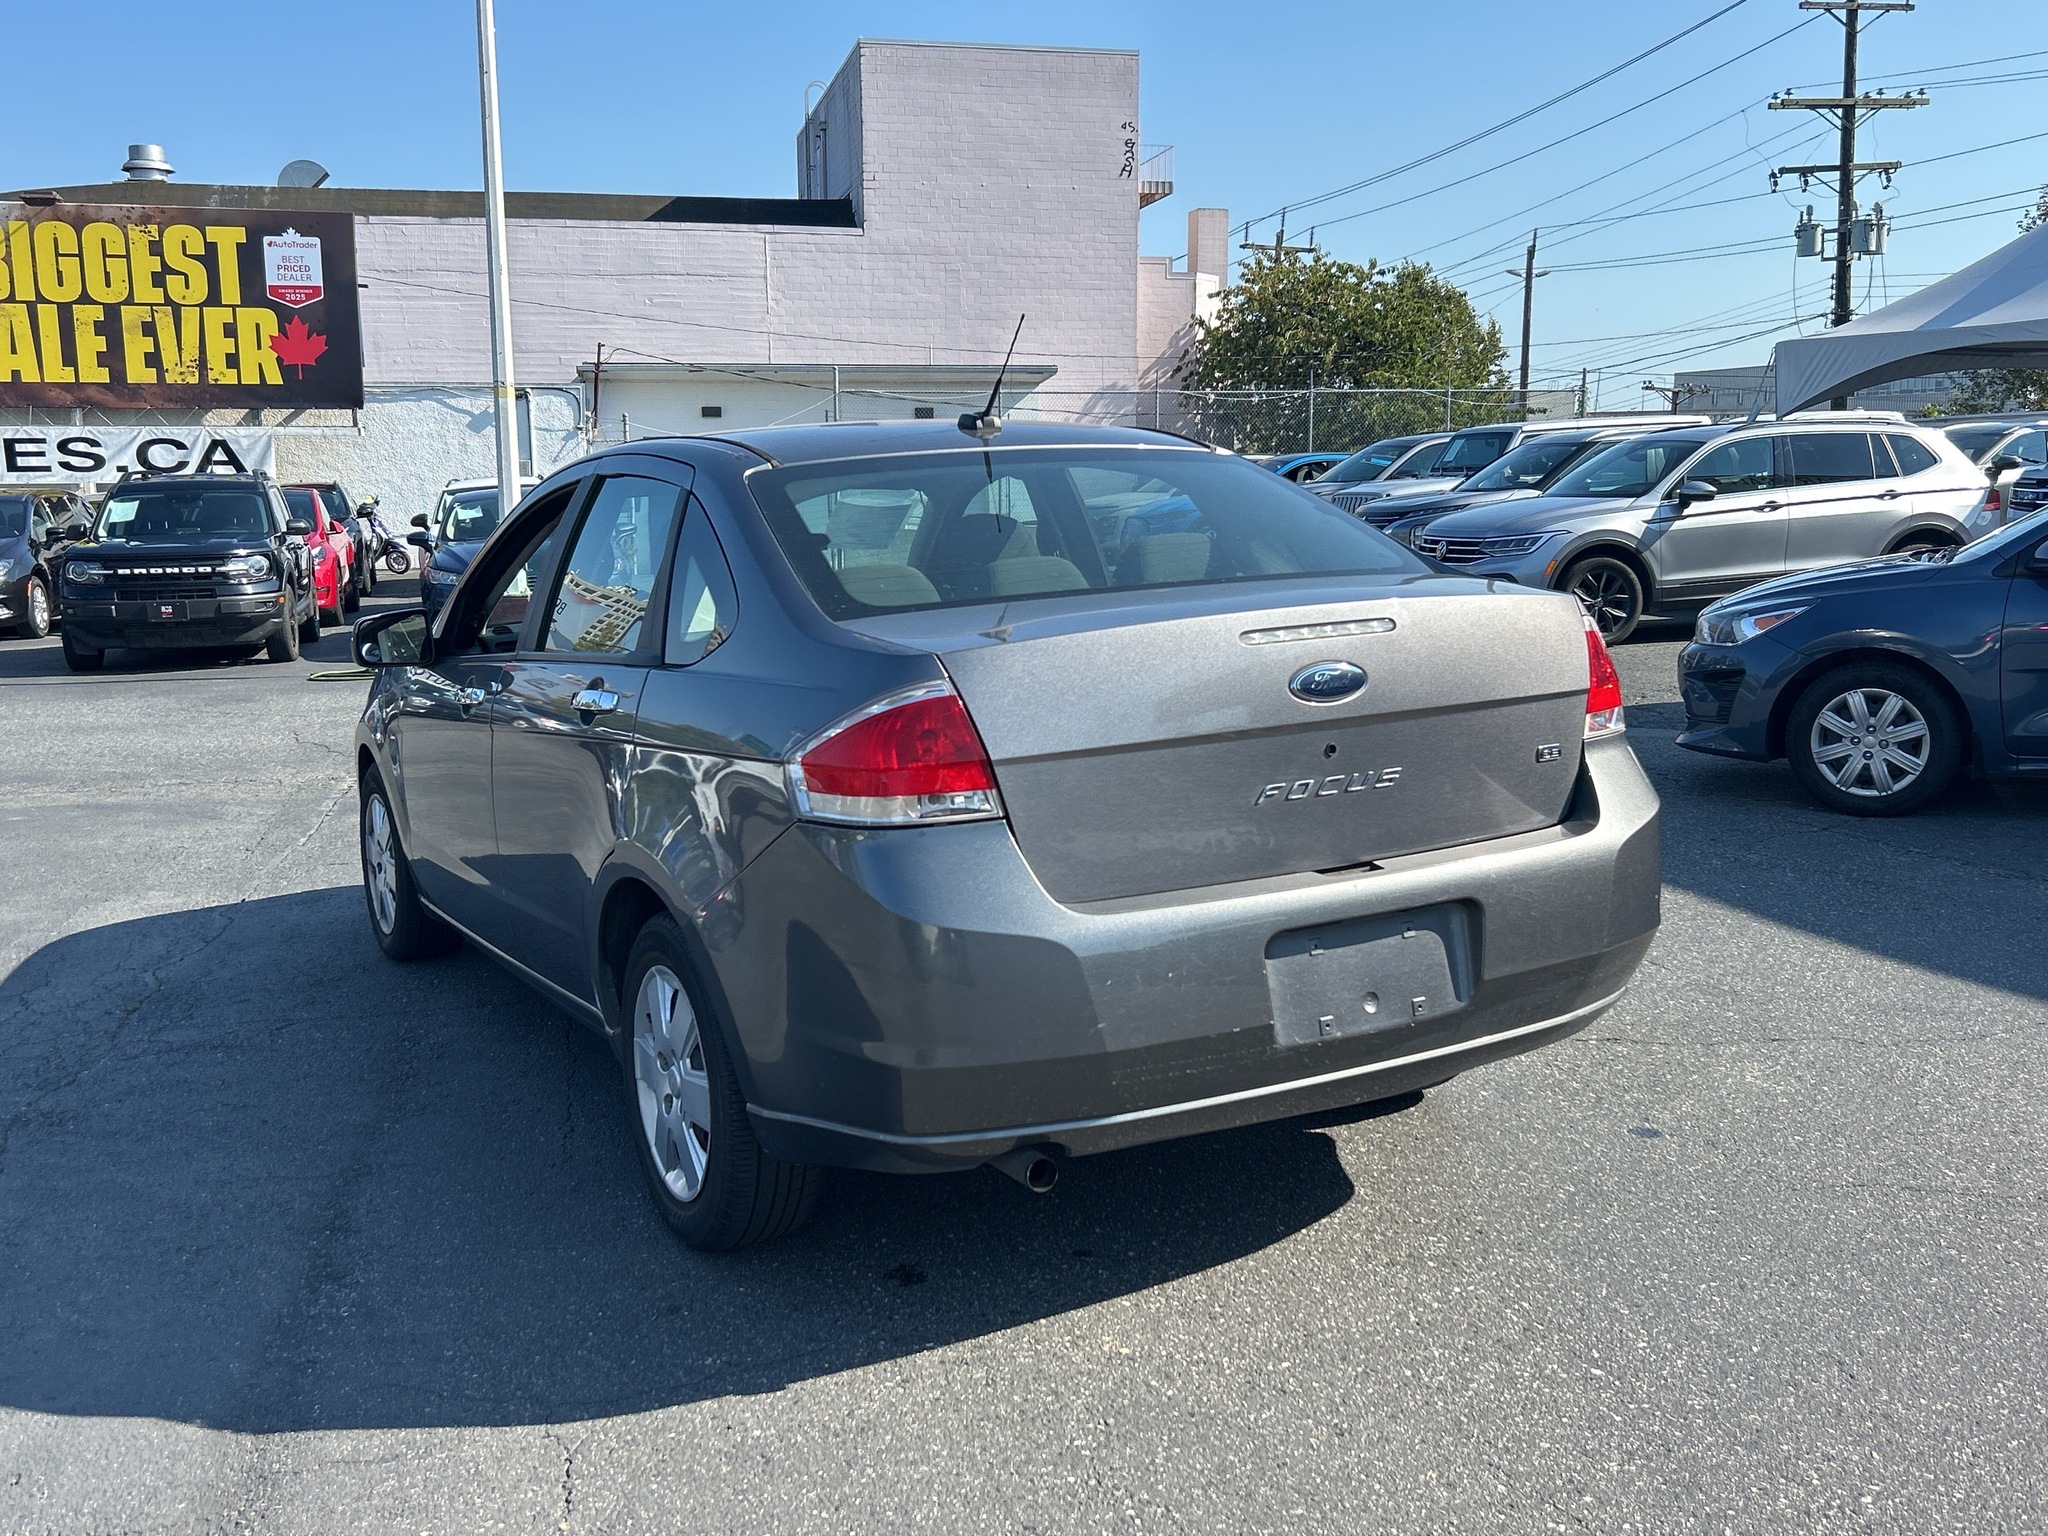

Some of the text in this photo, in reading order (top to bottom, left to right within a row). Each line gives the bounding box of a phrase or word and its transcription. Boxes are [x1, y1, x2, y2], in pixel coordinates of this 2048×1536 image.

[272, 241, 317, 249] AutoTrader
[0, 220, 247, 305] IGGEST
[281, 255, 305, 264] BEST
[277, 264, 311, 273] PRICED
[277, 273, 312, 282] DEALER
[285, 293, 306, 301] 2025
[121, 305, 284, 385] EVER
[2, 436, 250, 474] ES.CA
[117, 566, 212, 575] BRONCO
[1310, 669, 1352, 691] Ford
[1253, 766, 1402, 806] FOCUS
